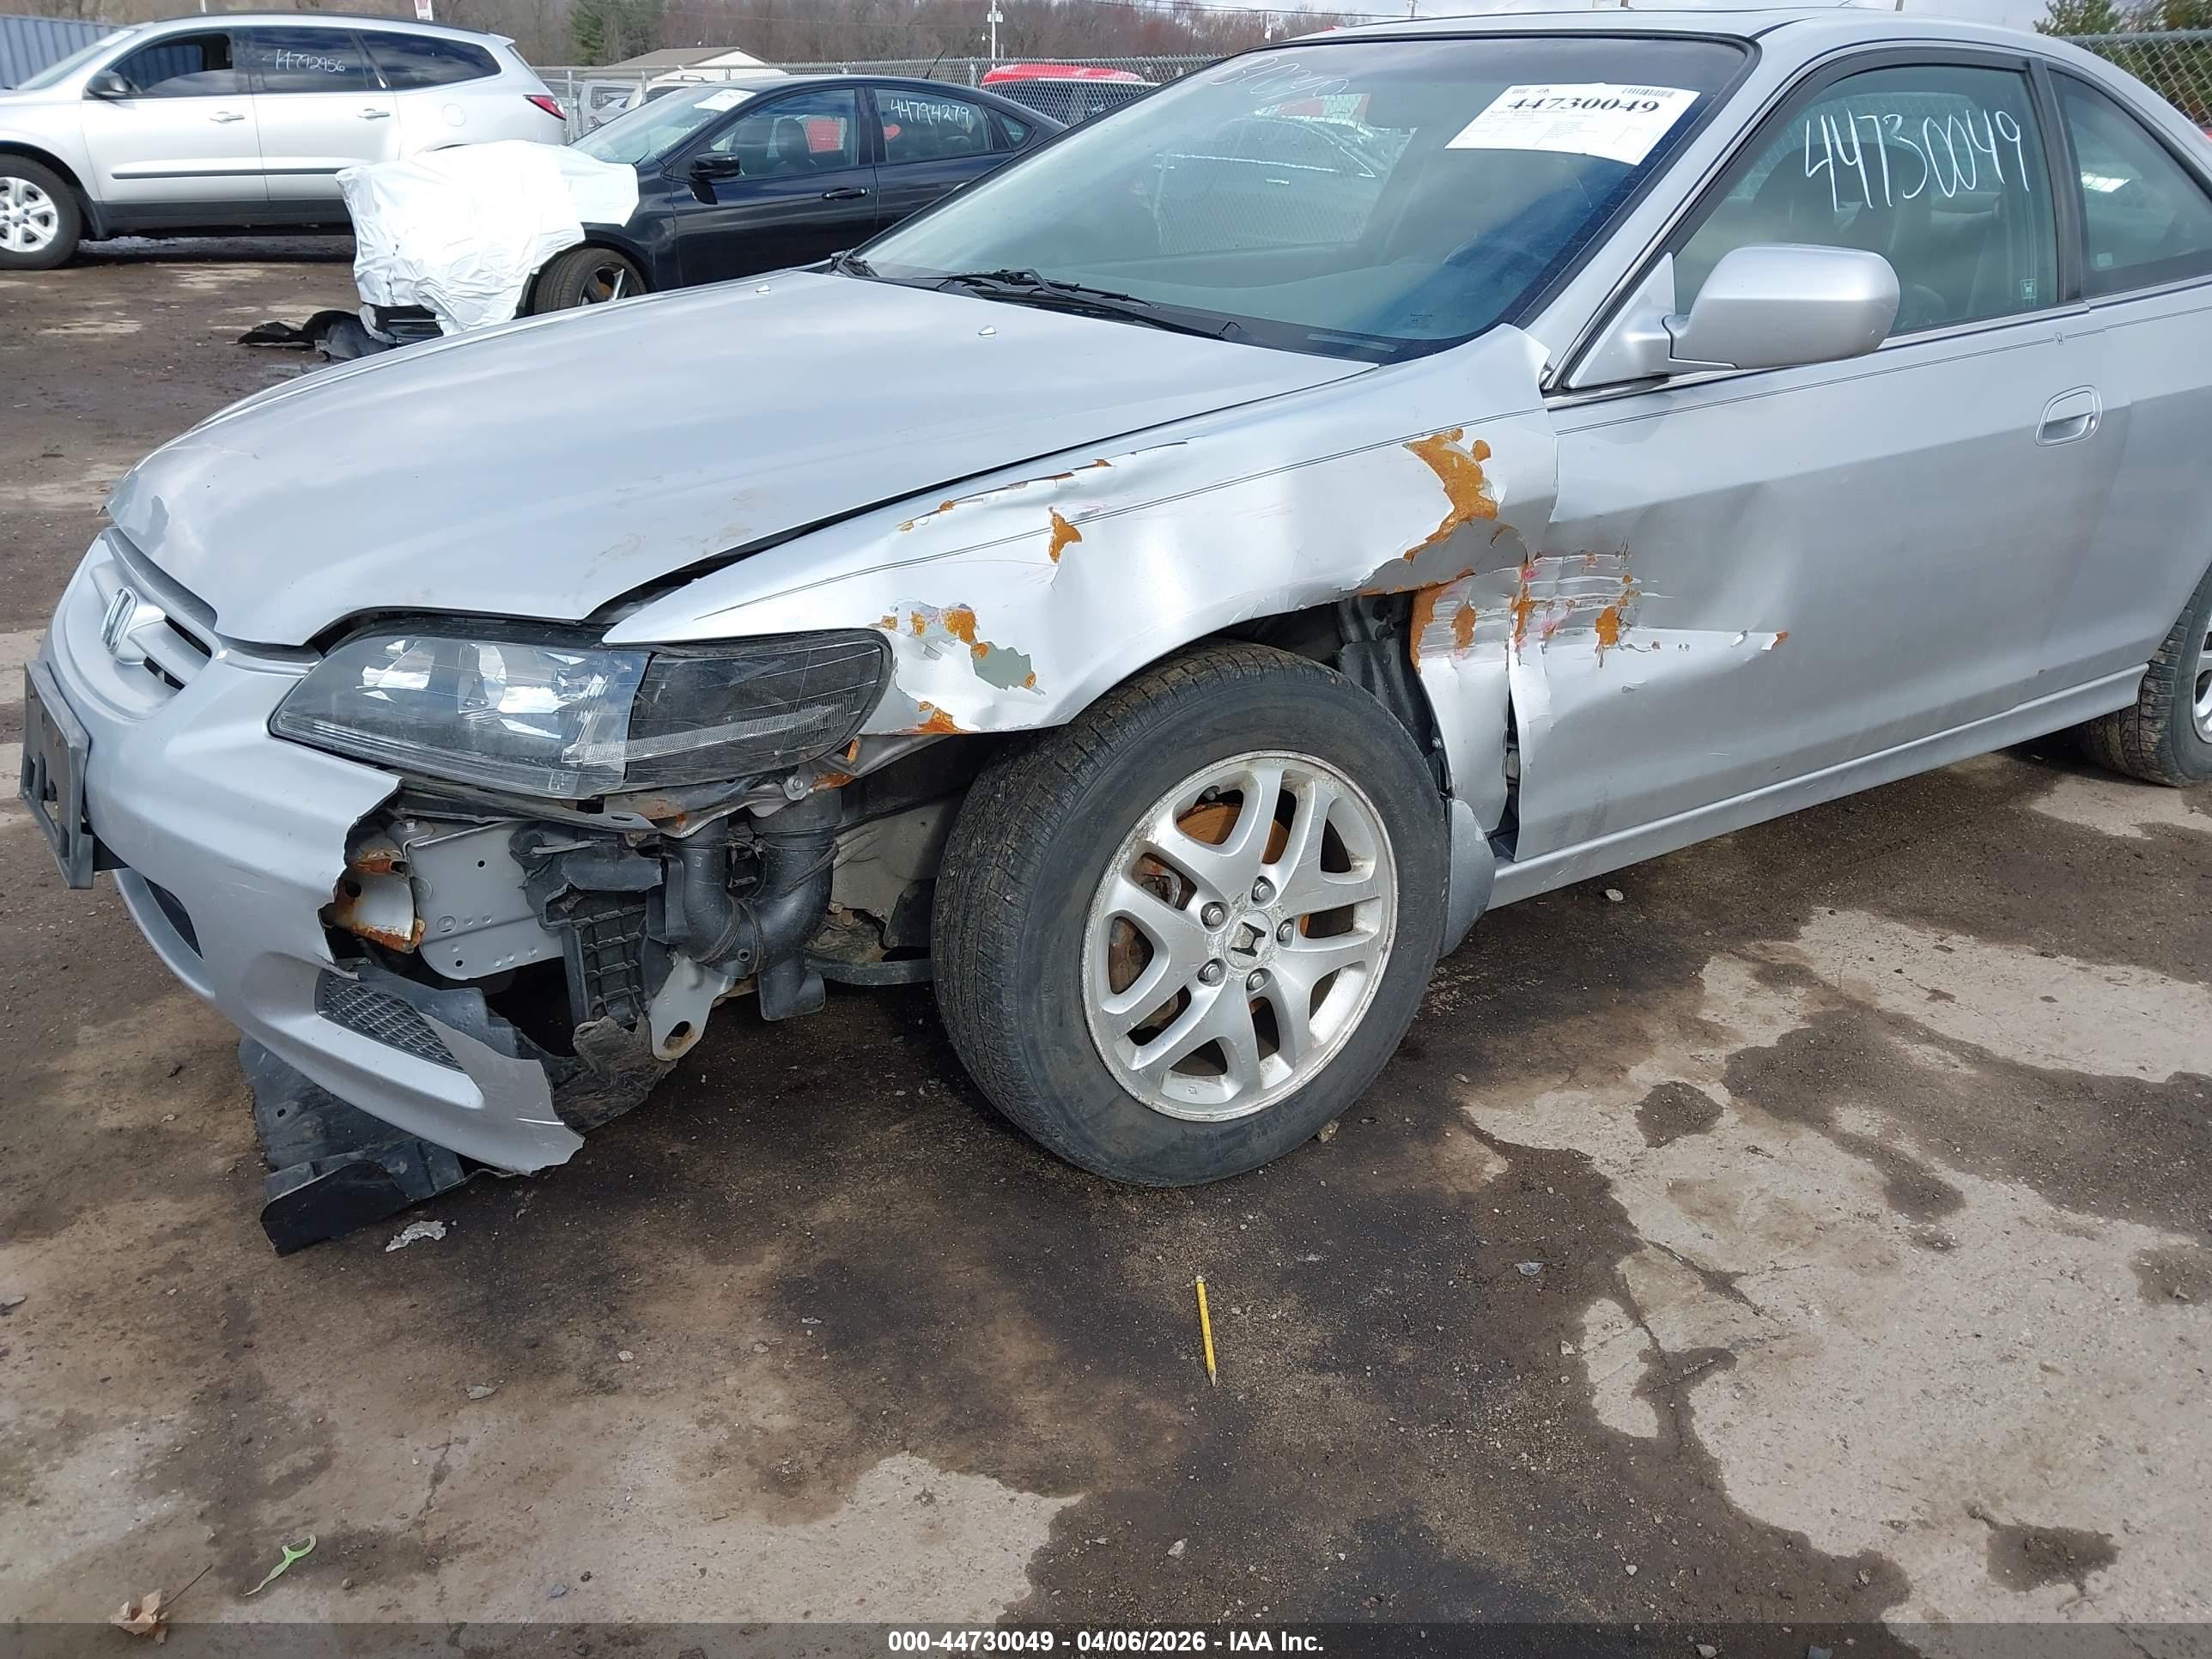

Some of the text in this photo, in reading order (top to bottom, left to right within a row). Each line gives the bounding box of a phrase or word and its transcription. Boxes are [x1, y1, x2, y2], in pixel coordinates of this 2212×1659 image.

[890, 99, 970, 126] 44794279
[1507, 97, 1660, 113] 44730049
[1805, 108, 2030, 212] 44730049
